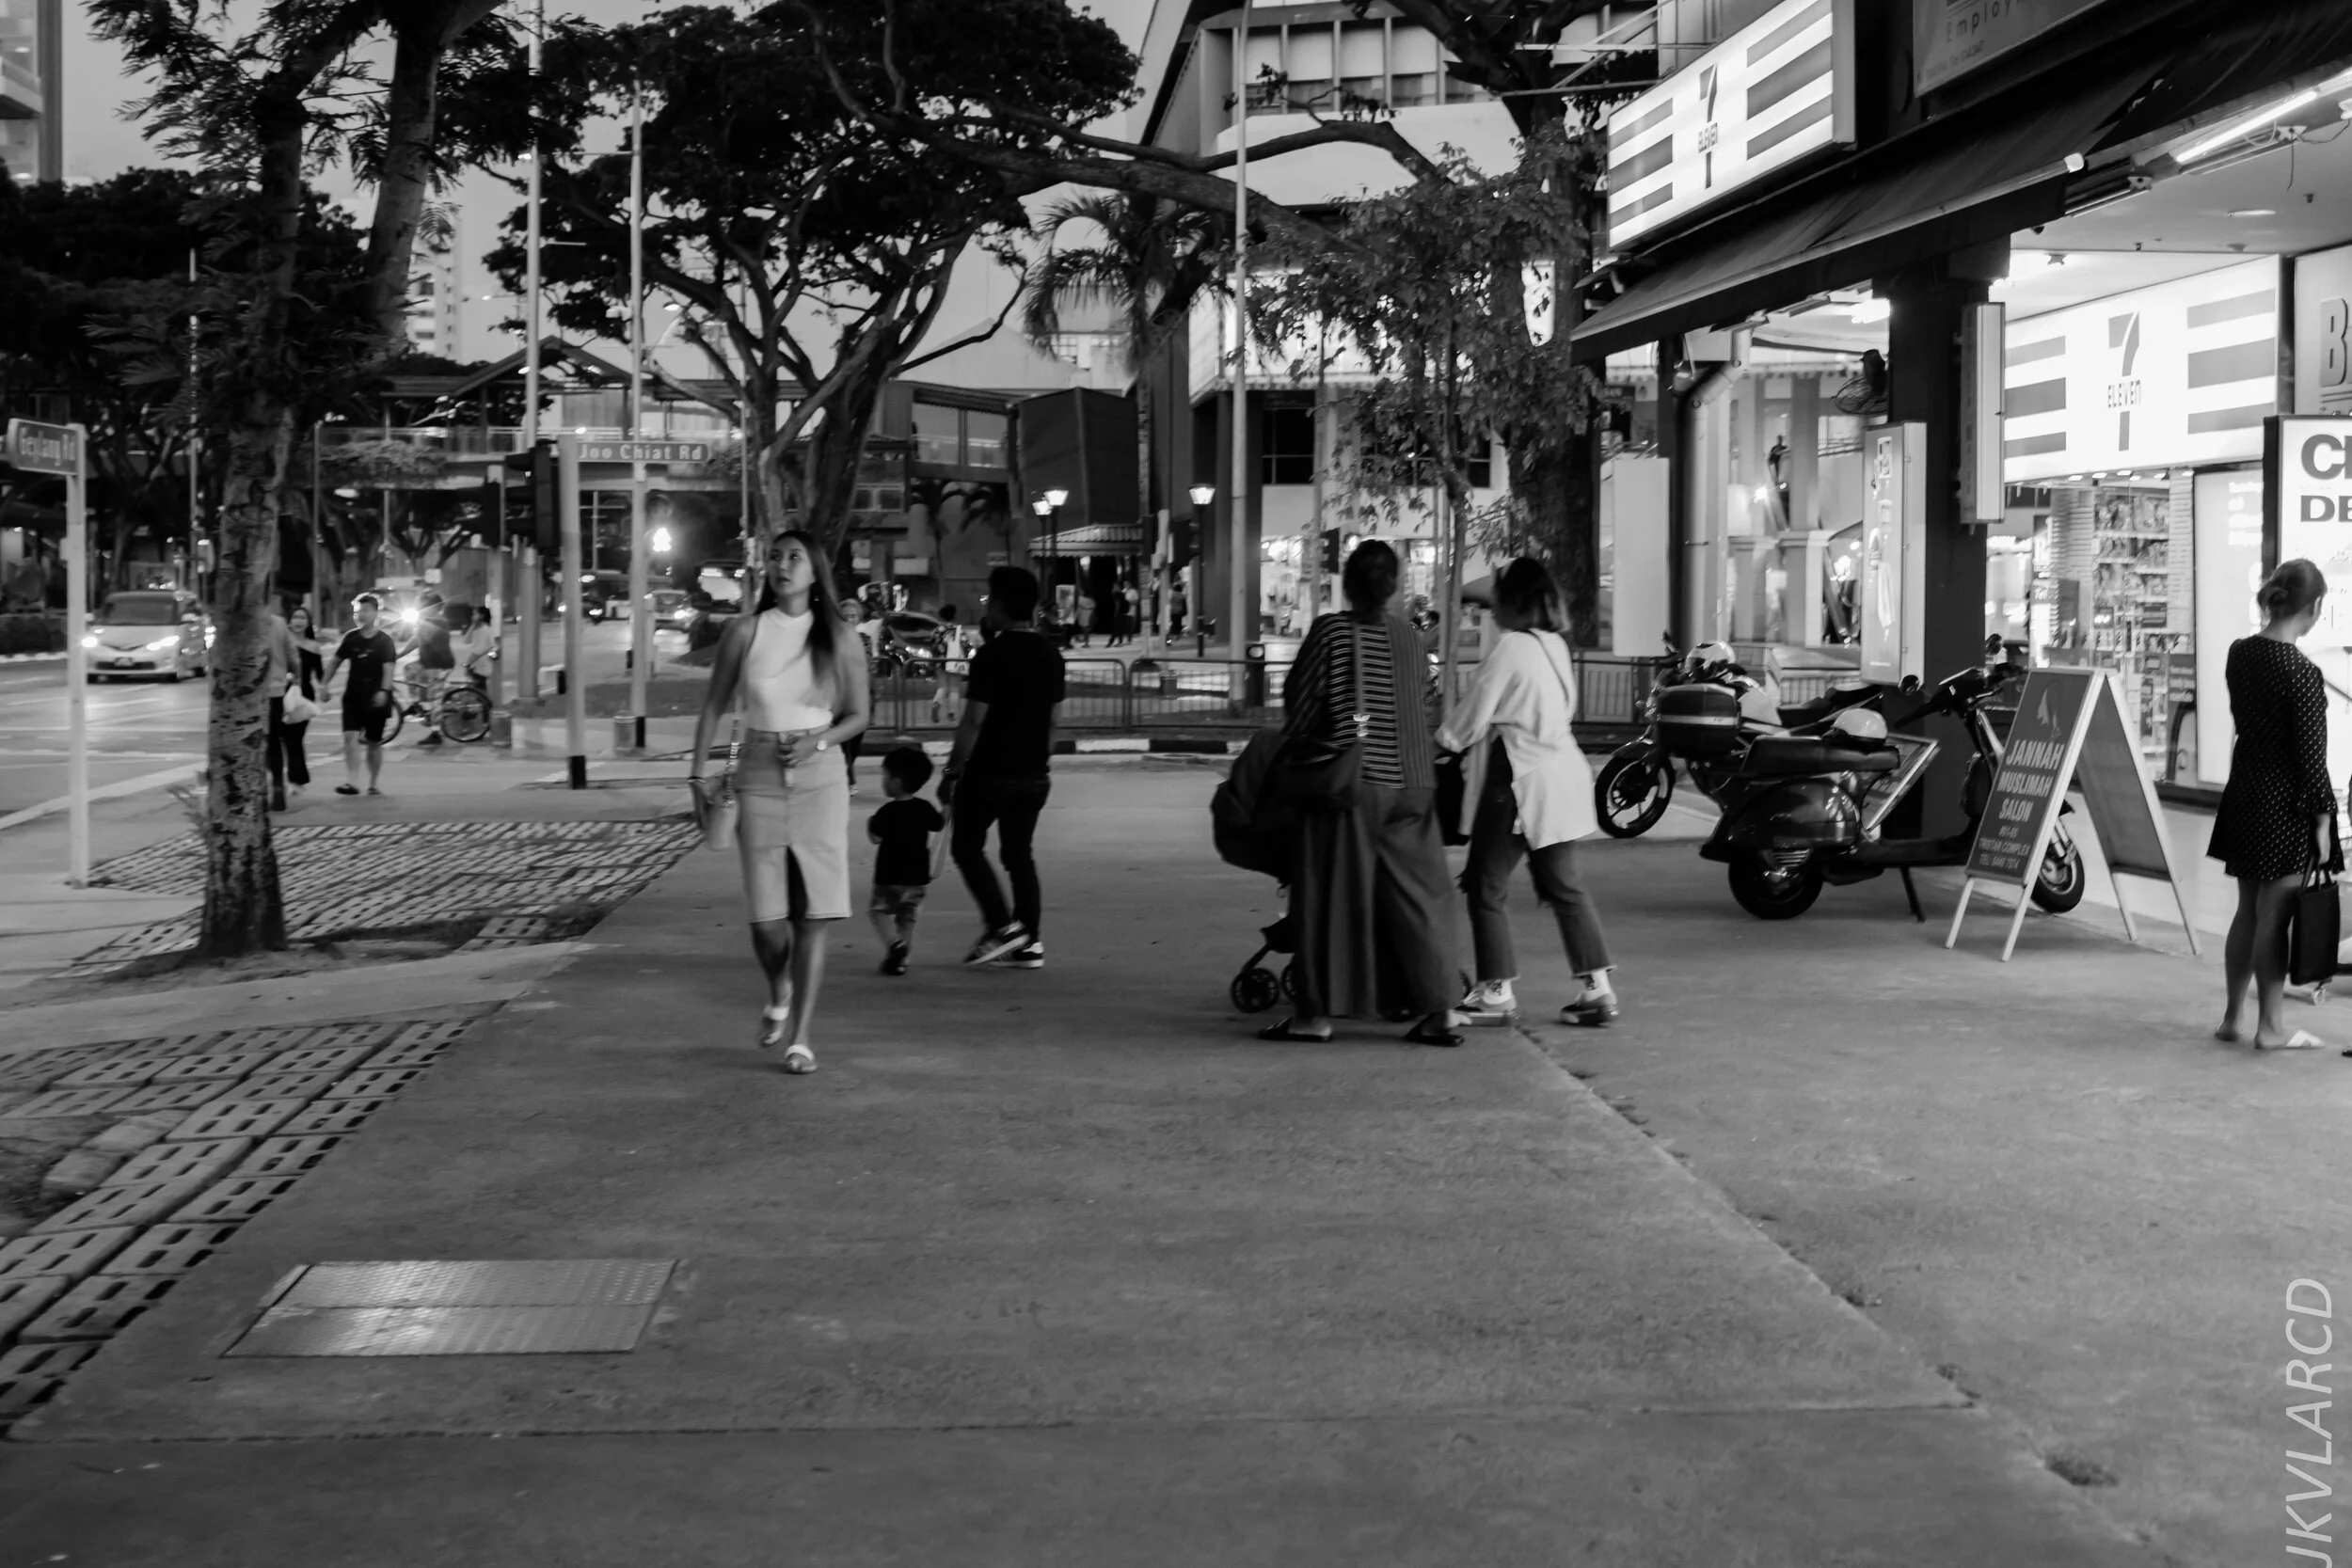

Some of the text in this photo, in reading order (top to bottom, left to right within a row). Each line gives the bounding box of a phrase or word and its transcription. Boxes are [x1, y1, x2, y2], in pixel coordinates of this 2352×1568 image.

[1946, 0, 2020, 42] Employ
[1699, 63, 1718, 189] 7
[2319, 297, 2352, 388] B
[2108, 312, 2140, 451] 7
[579, 444, 702, 460] Joo Chiat Rd
[2301, 434, 2352, 481] C
[2006, 739, 2065, 770] JANNAH
[1996, 771, 2054, 798] MUSLIMAH
[1998, 798, 2034, 822] SALON
